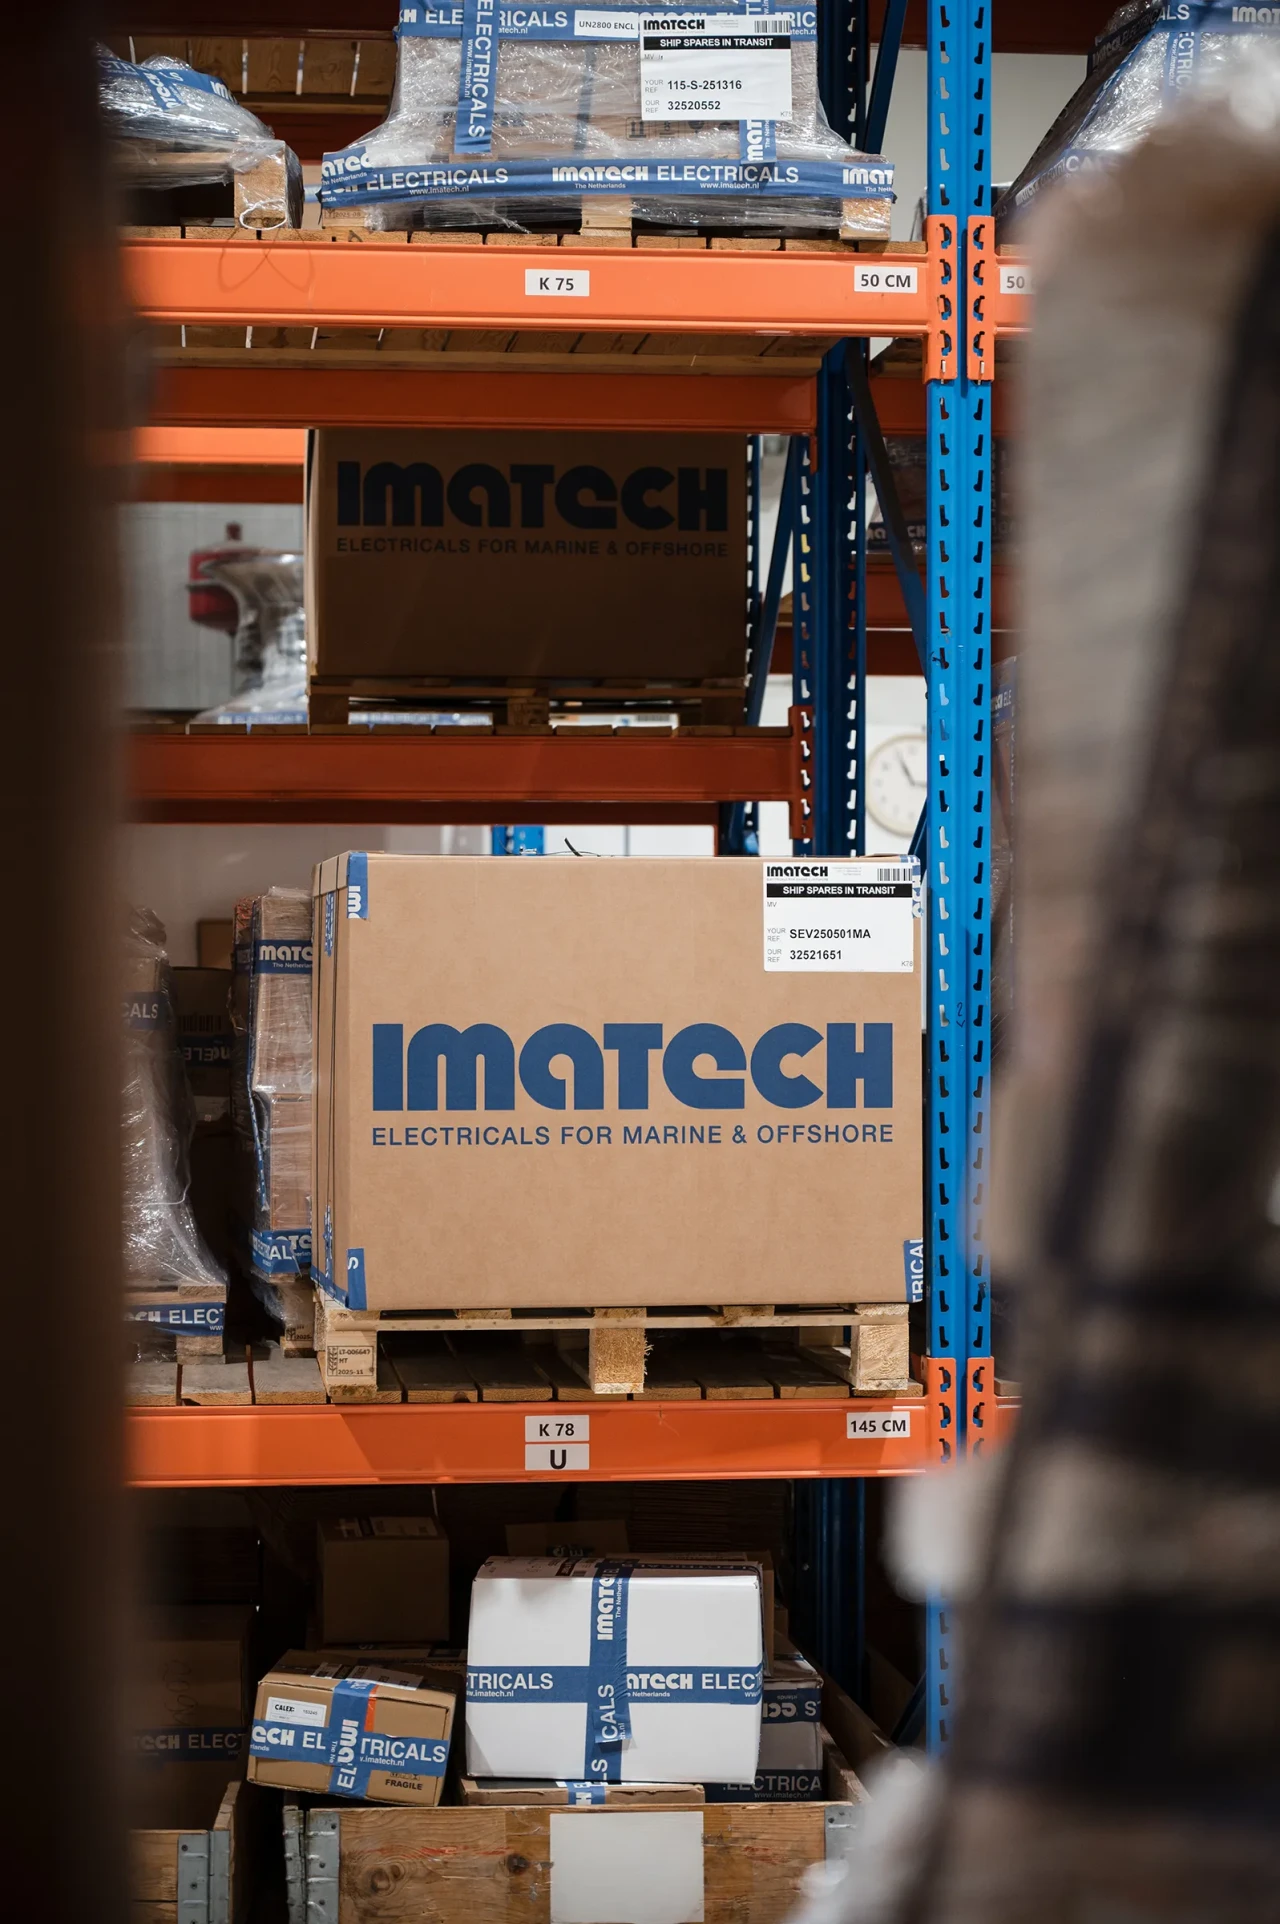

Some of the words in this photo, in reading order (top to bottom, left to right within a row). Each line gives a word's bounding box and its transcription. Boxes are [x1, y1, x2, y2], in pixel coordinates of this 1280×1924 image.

[579, 21, 611, 29] UN2800
[614, 22, 634, 30] ENCL
[643, 19, 705, 31] IMATECH
[660, 38, 681, 47] SHIP
[683, 38, 720, 47] SPARES
[721, 38, 732, 47] IN
[733, 38, 774, 47] TRANSIT
[464, 39, 474, 98] www.imatech.nl
[645, 79, 664, 87] YOUR
[667, 79, 742, 91] 115-S-251316
[645, 87, 658, 95] REF
[645, 99, 660, 107] OUR
[667, 100, 721, 111] 32520552
[552, 166, 649, 182] IMATECH
[657, 165, 799, 183] ELECTRICALS
[409, 185, 470, 196] www.imatech.nl
[699, 182, 760, 190] www.imatech.nl
[539, 276, 550, 291] K
[554, 276, 575, 291] 75
[860, 273, 880, 288] 50
[883, 273, 912, 289] CM
[1006, 275, 1025, 289] 50
[337, 461, 728, 531] IMATECH
[337, 537, 470, 554] ELECTRICALS
[478, 539, 517, 554] FOR
[525, 540, 600, 556] MARINE
[607, 541, 618, 556] &
[625, 541, 728, 557] OFFSHORE
[766, 866, 829, 877] IMATECH
[782, 886, 805, 895] SHIP
[806, 886, 843, 895] SPARES
[844, 886, 855, 895] IN
[856, 886, 896, 895] TRANSIT
[789, 929, 871, 939] SEV250501MA
[789, 950, 842, 960] 32521651
[372, 1022, 893, 1111] IMATECH
[372, 1126, 550, 1146] ELECTRICALS
[561, 1126, 613, 1146] FOR
[623, 1125, 722, 1145] MARINE
[732, 1125, 748, 1145] &
[757, 1124, 893, 1144] OFFSHORE
[539, 1423, 550, 1437] K
[555, 1423, 575, 1437] 78
[850, 1420, 877, 1433] 145
[882, 1419, 907, 1432] CM
[549, 1449, 567, 1470] U
[385, 1779, 423, 1791] FRAGILE
